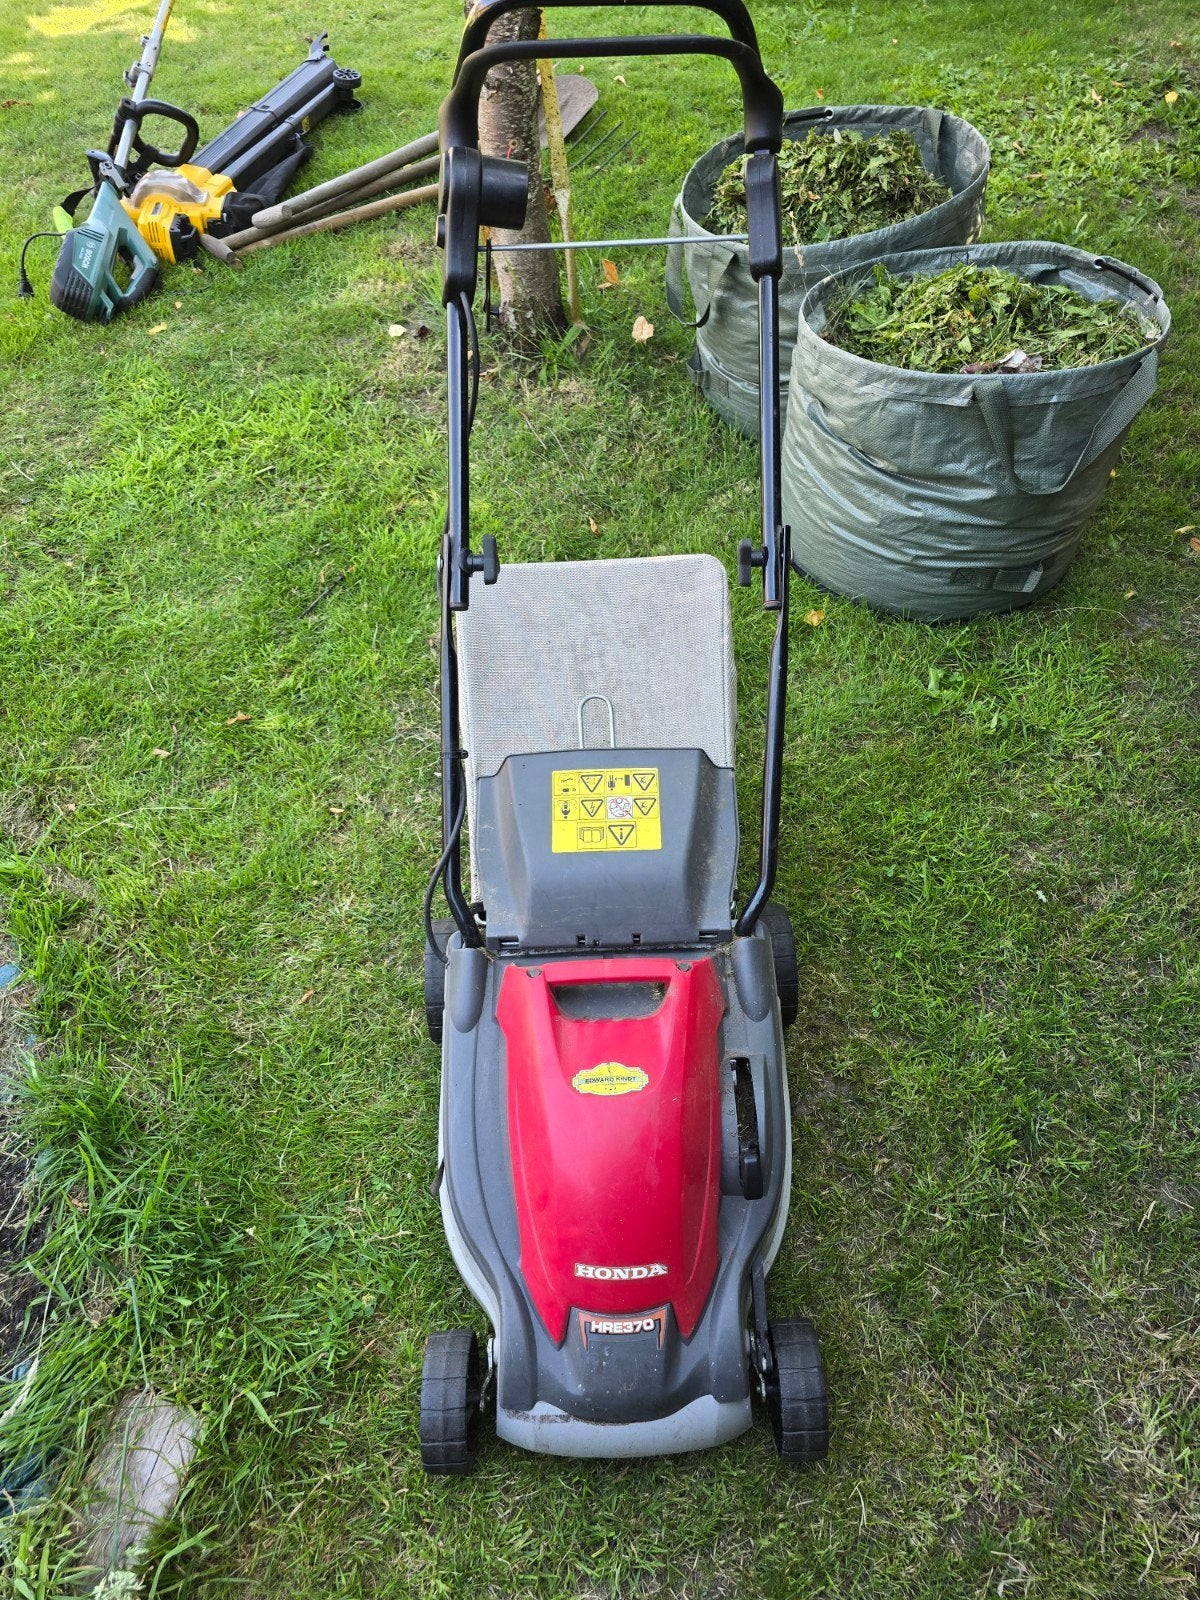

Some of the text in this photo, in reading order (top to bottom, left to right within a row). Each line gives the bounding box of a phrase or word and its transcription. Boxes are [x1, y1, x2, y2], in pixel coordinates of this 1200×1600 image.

[82, 249, 93, 269] BOSCH
[575, 1263, 667, 1280] HONDA
[590, 1319, 655, 1334] HRE370
